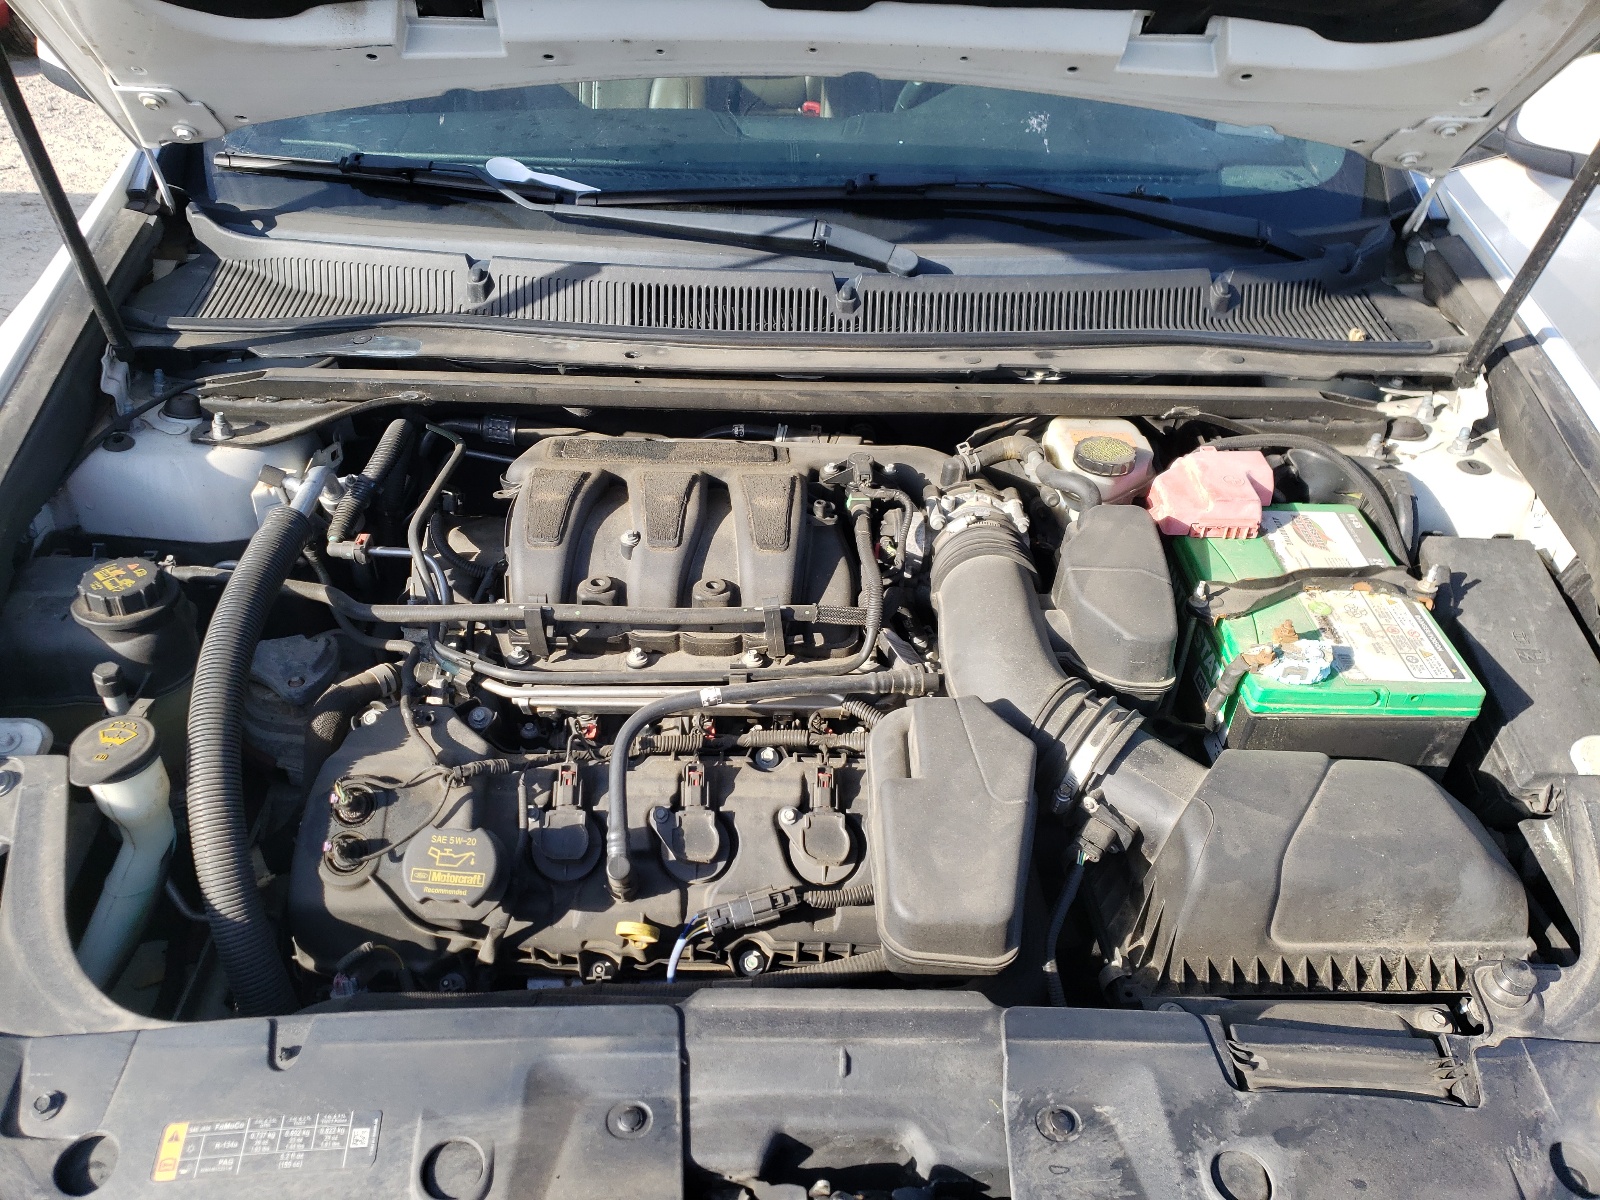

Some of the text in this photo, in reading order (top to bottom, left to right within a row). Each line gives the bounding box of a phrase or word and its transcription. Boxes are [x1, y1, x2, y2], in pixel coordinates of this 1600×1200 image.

[431, 834, 448, 844] SAE
[431, 871, 483, 885] Motorcraft
[423, 886, 468, 896] Recommended
[214, 1122, 245, 1131] FoMoCo
